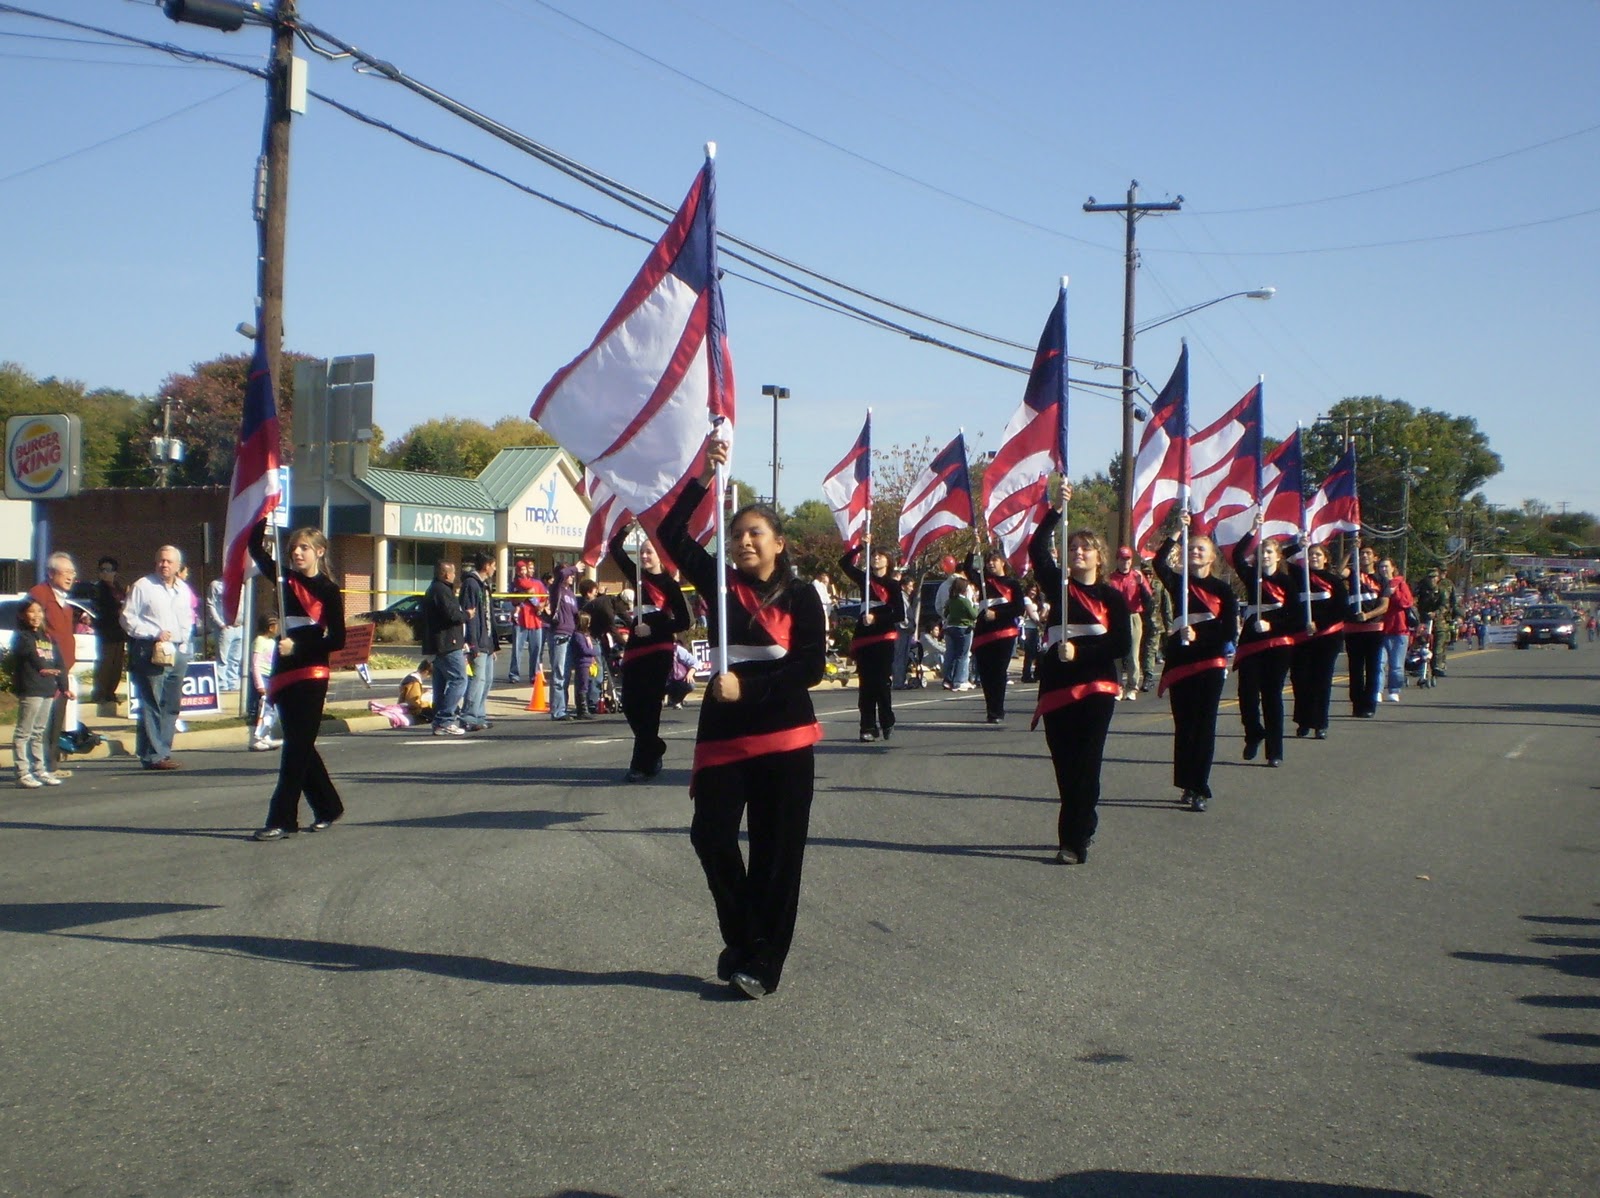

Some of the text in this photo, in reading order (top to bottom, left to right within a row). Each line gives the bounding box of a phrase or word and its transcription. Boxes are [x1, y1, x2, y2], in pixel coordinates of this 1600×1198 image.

[16, 432, 59, 459] BURGER
[17, 445, 61, 478] KING
[414, 512, 485, 537] AEROBICS
[545, 525, 583, 538] FITNESS
[181, 675, 215, 695] an
[180, 697, 210, 706] GRESS
